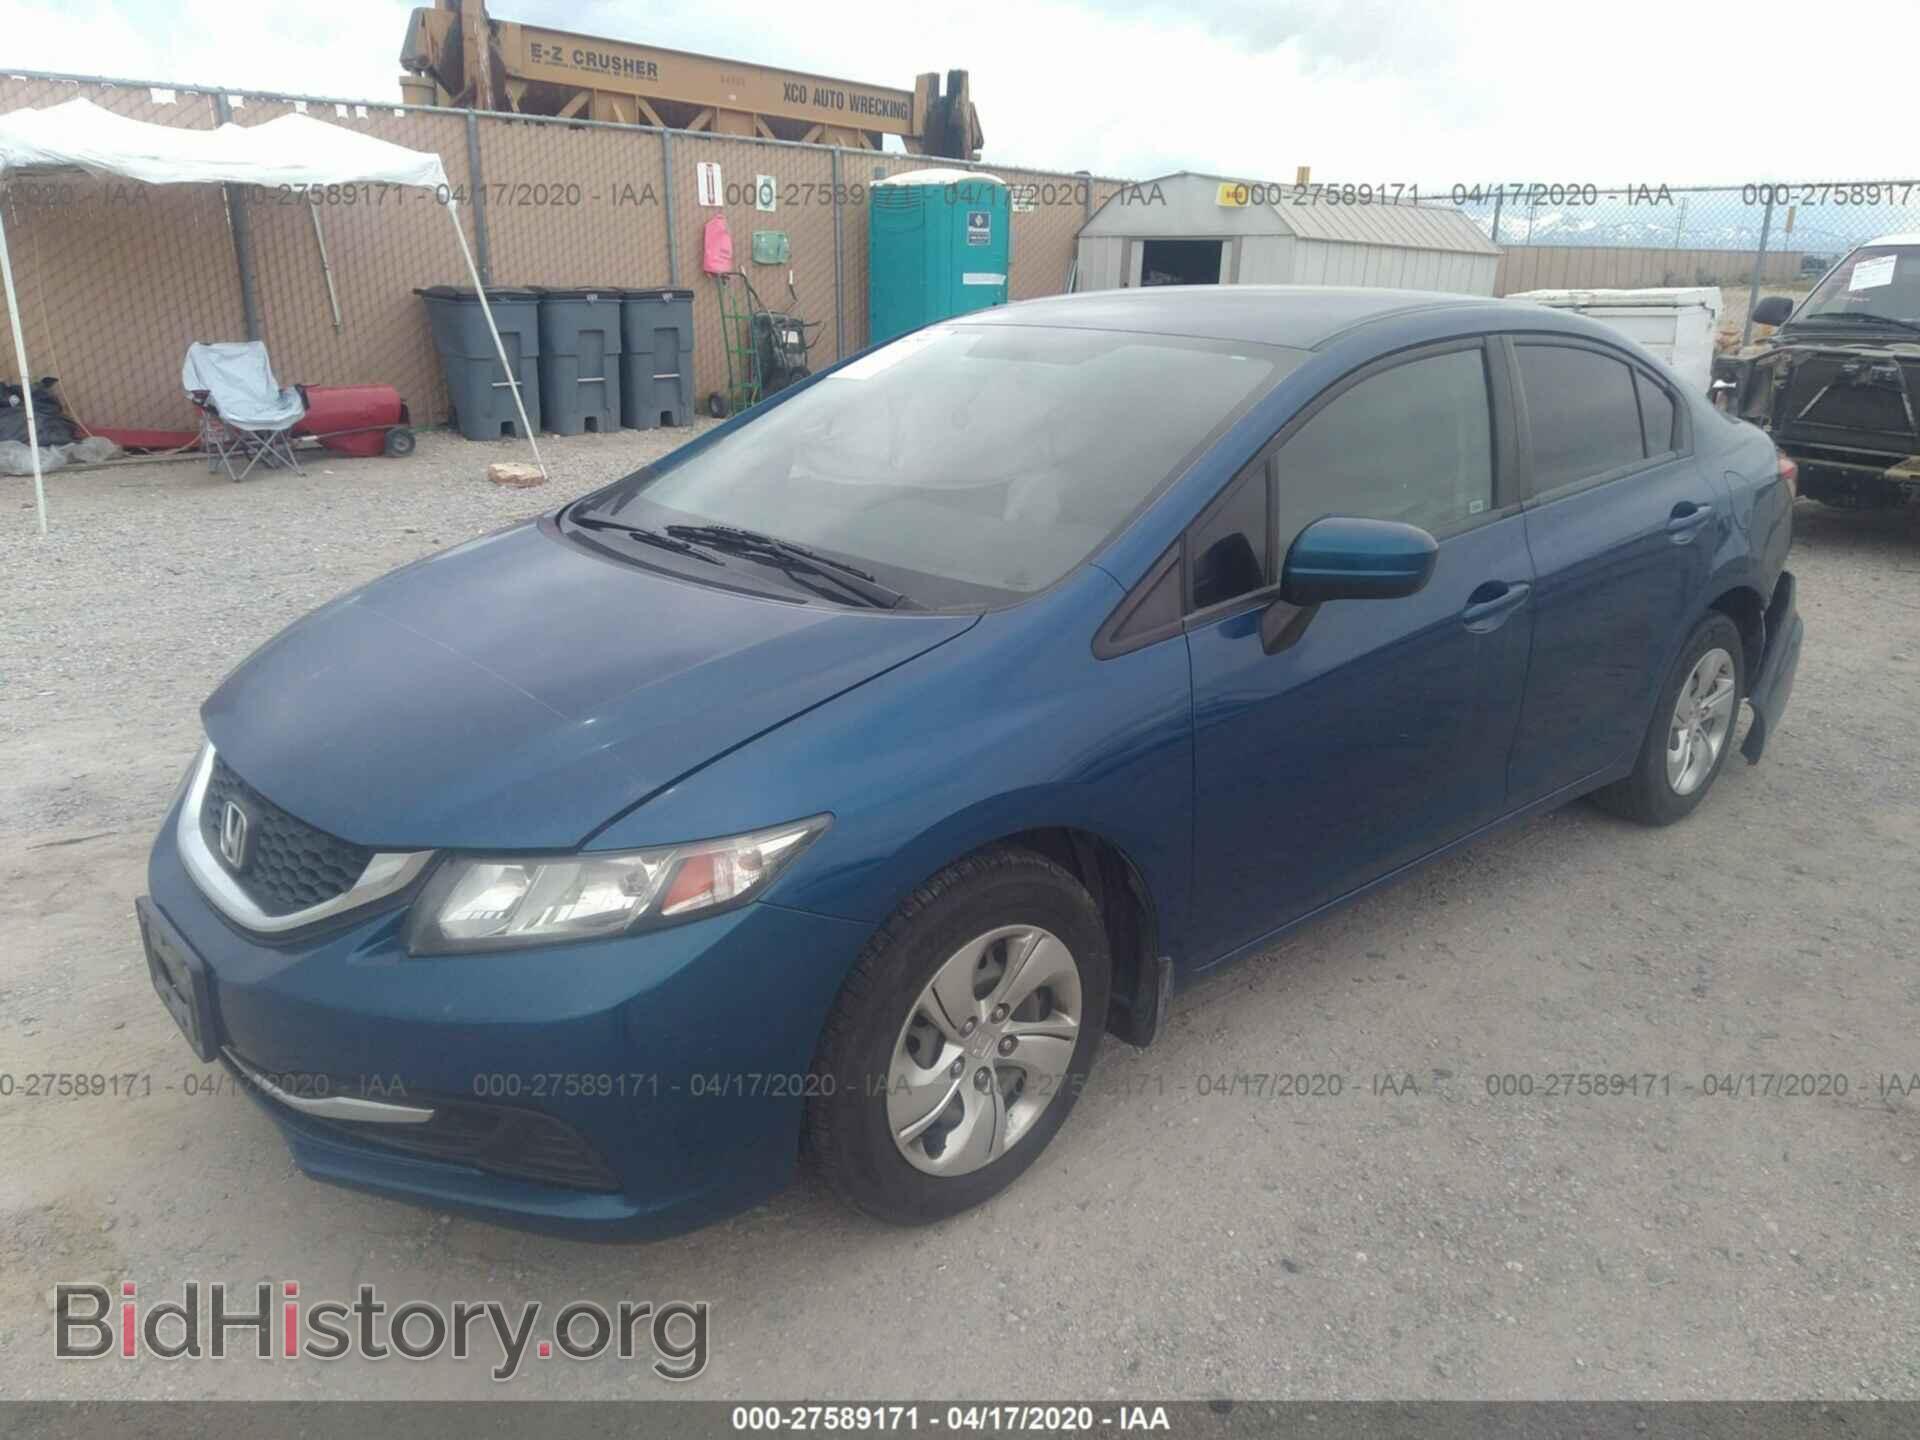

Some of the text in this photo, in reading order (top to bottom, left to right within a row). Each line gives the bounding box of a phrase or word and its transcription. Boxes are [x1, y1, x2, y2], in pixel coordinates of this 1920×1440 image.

[530, 42, 563, 62] E-Z
[572, 49, 659, 77] CRUSHER
[783, 82, 909, 120] XCO AUTO WRECKING
